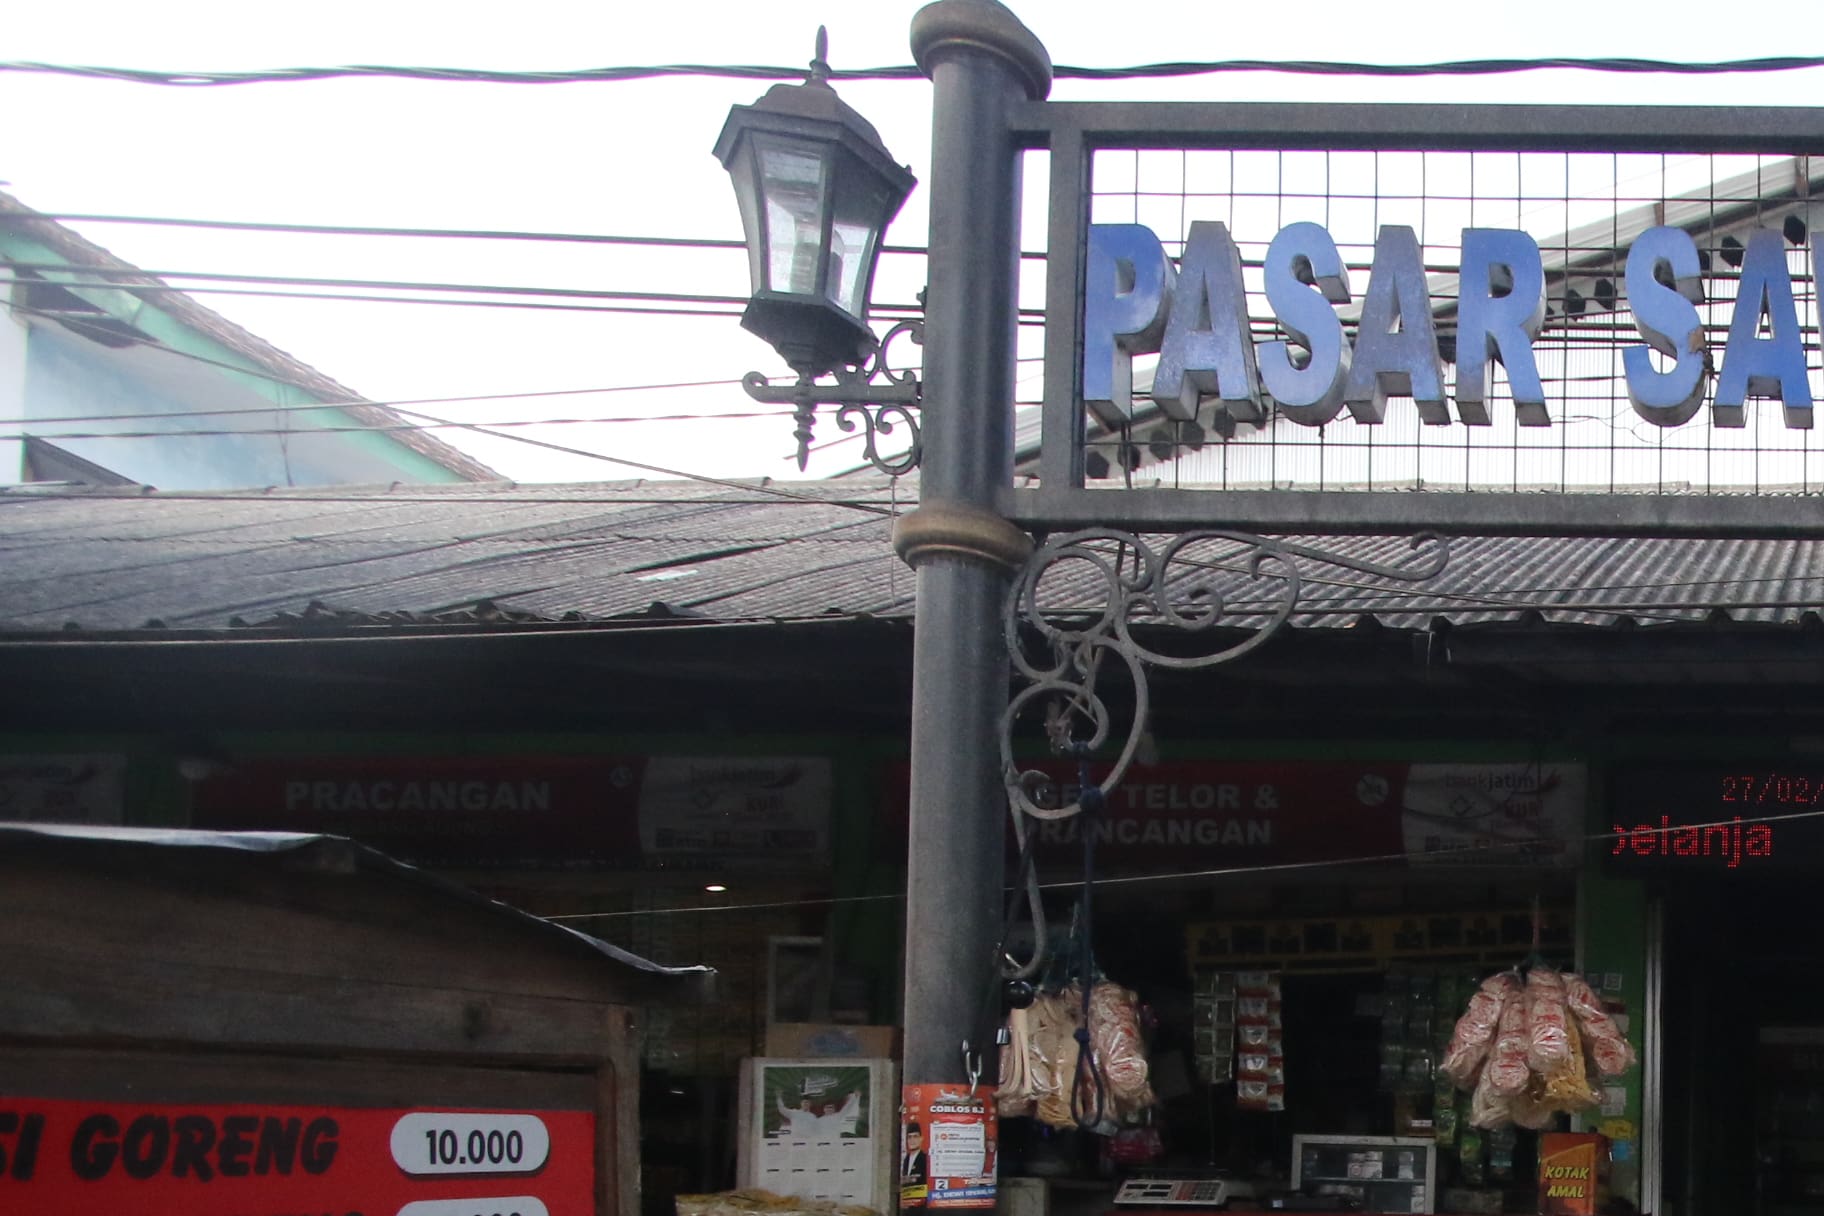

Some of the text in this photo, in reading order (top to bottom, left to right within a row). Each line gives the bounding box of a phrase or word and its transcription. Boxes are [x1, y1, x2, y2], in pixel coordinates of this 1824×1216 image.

[1084, 220, 1551, 427] PASAR
[285, 780, 551, 811] PRACANGAN
[1121, 783, 1241, 809] TELOR
[1254, 784, 1280, 809] &
[930, 1105, 970, 1114] COBLOS
[70, 1113, 340, 1182] GORENG
[426, 1130, 524, 1166] 10.000
[938, 1180, 945, 1190] 2
[1545, 1166, 1589, 1179] KOTAK
[1547, 1185, 1584, 1198] AMAL
